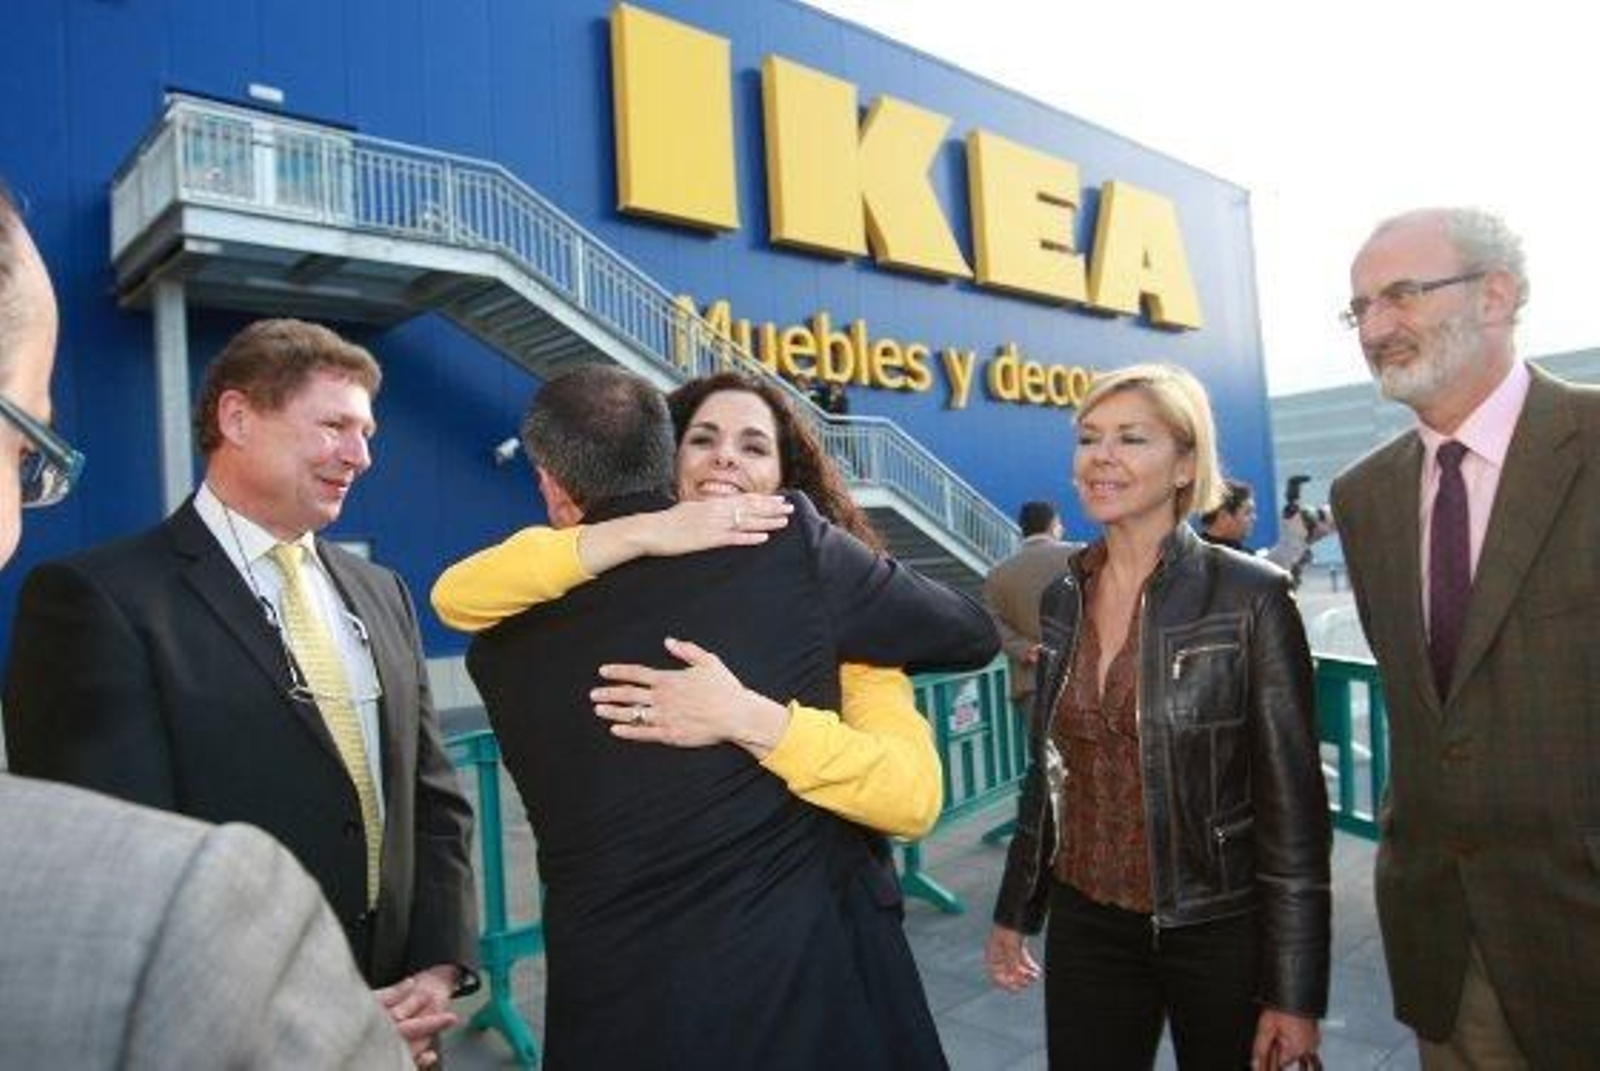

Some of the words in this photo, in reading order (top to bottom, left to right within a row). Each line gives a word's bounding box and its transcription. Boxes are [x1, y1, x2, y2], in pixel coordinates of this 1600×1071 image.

[610, 2, 1202, 330] IKEA
[673, 294, 932, 392] Muebles
[942, 346, 976, 409] y
